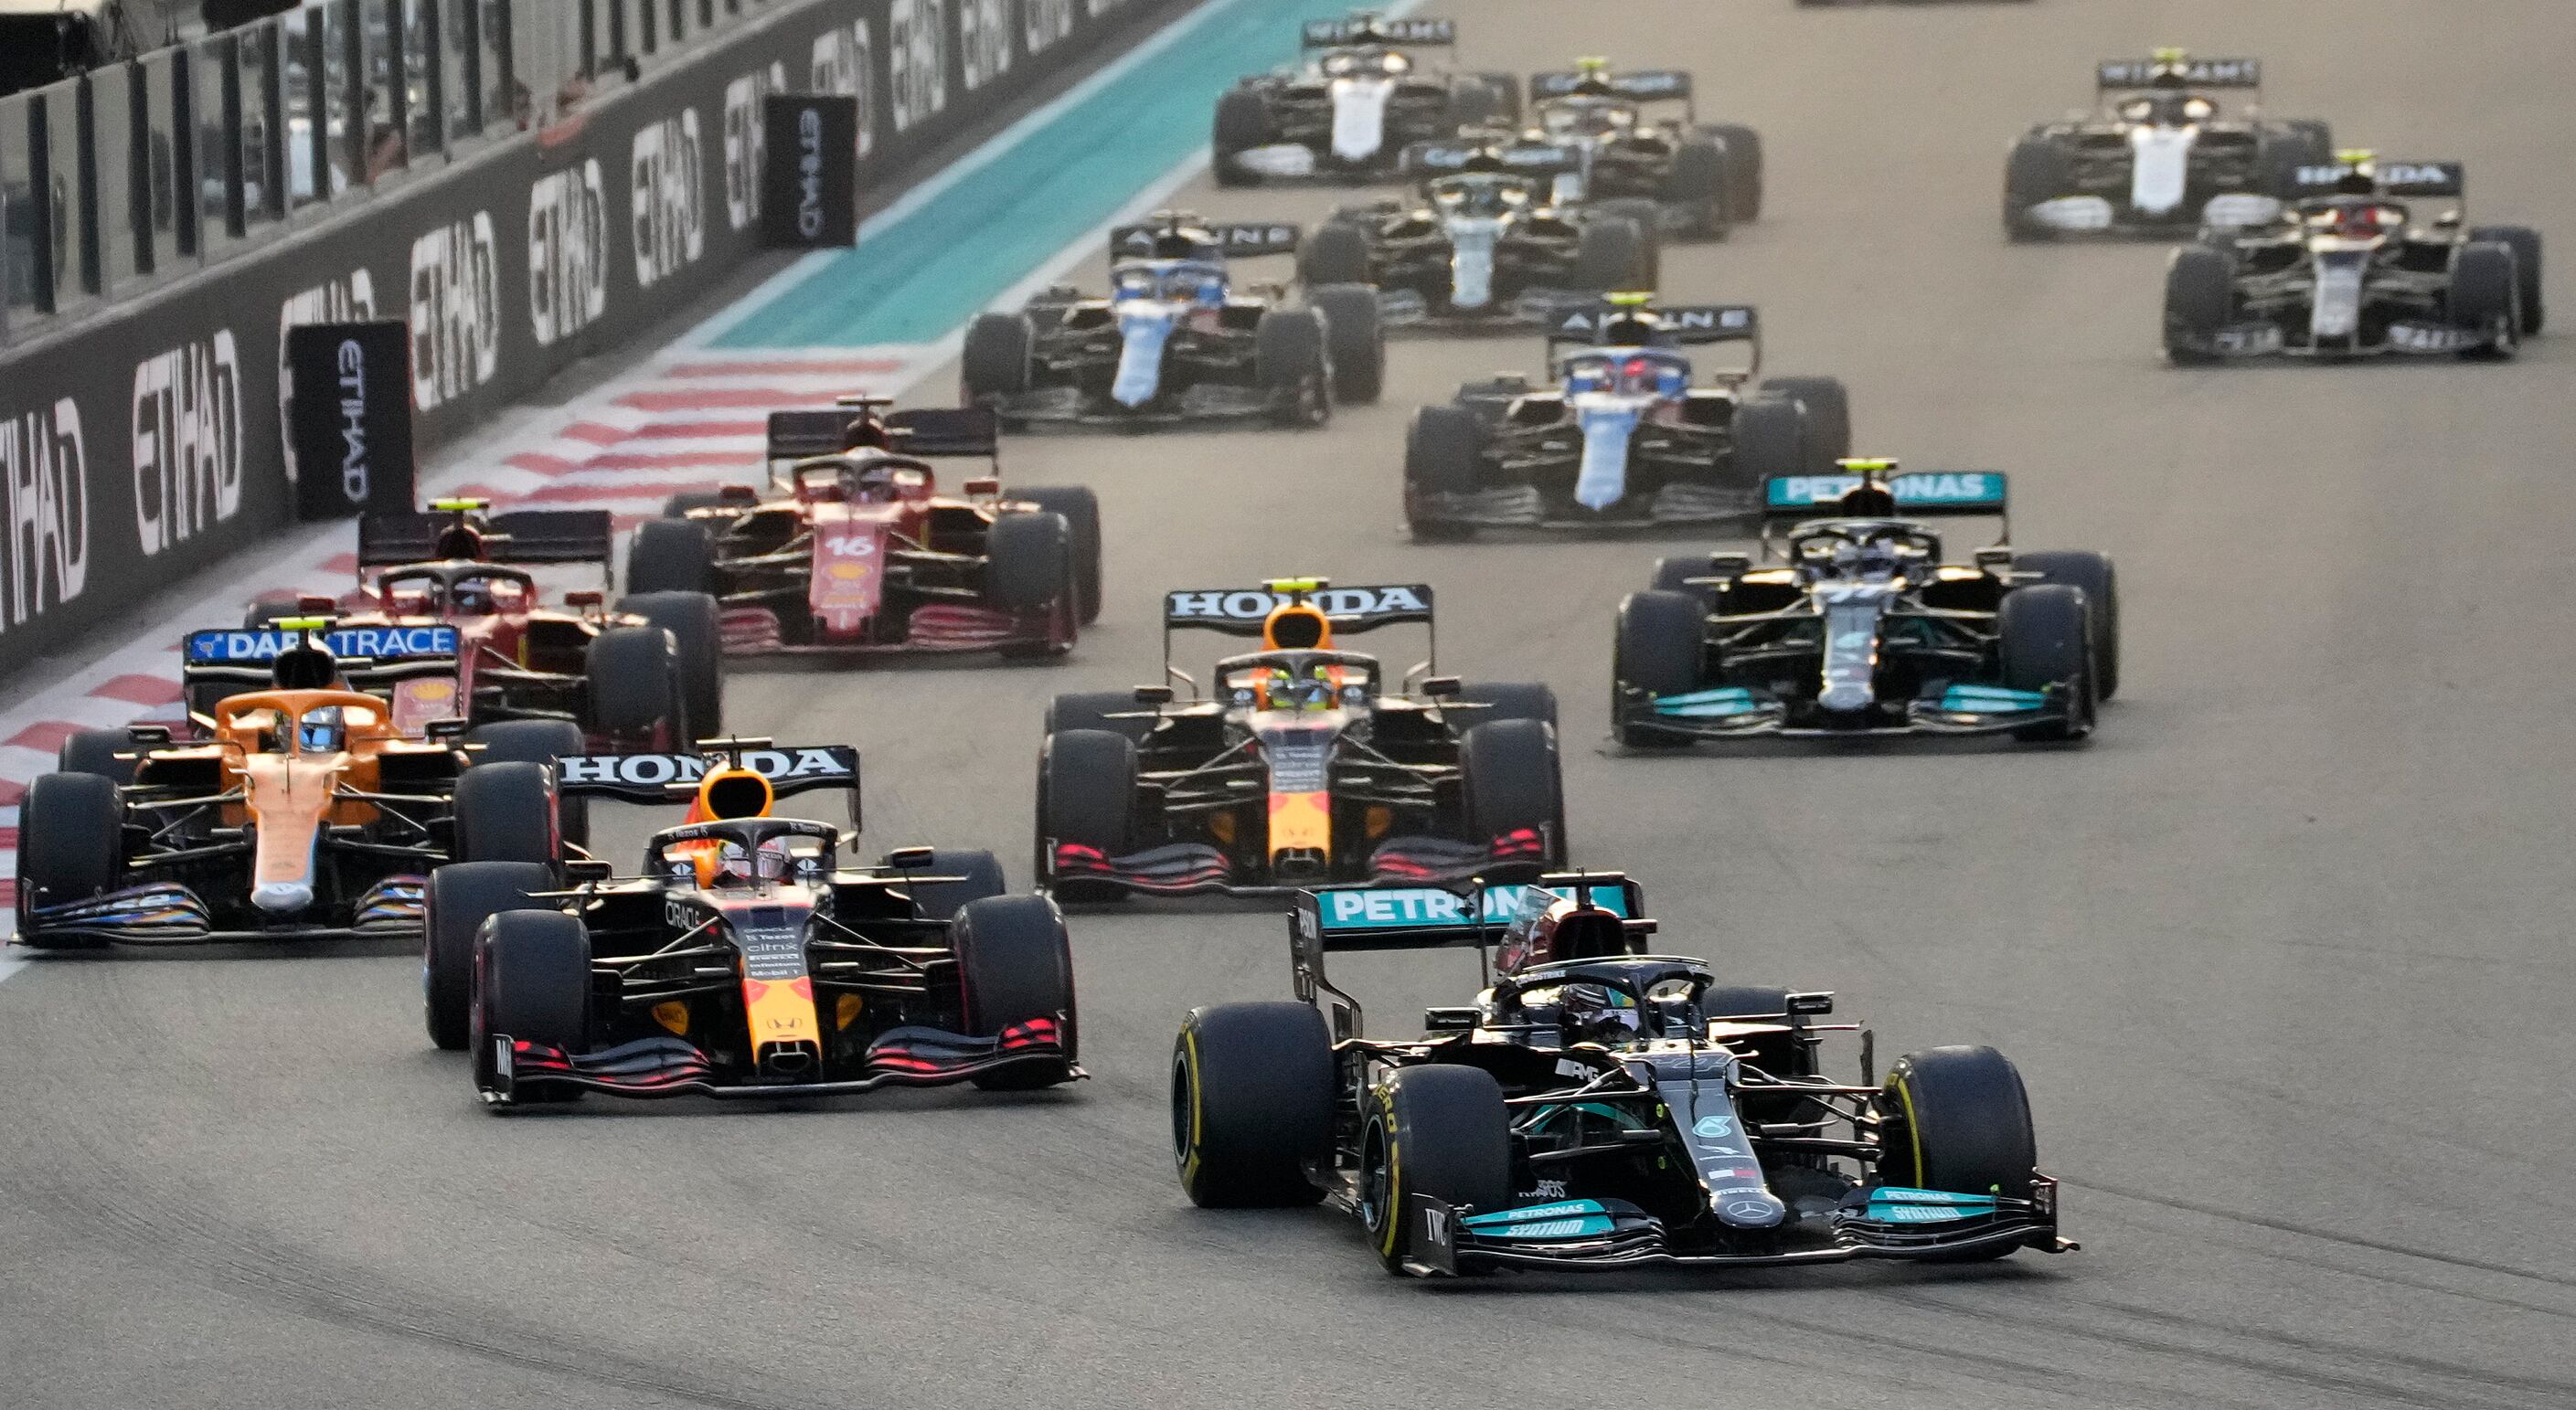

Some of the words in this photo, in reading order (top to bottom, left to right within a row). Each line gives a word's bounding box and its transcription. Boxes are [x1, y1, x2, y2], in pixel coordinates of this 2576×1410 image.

[1306, 21, 1449, 38] WIAMS
[2104, 61, 2255, 80] WIAMS
[410, 210, 499, 411] ETIHAD
[338, 339, 369, 502] ETIHAD
[133, 328, 242, 556] ETIHAD
[1785, 474, 1985, 501] PETONAS
[0, 397, 87, 632] IHAD
[825, 535, 875, 556] 16
[228, 627, 454, 659] DARTRACE
[1572, 1062, 1600, 1083] AMG
[1884, 1191, 1953, 1202] PETRONAS
[1507, 1203, 1585, 1219] PETRONAS
